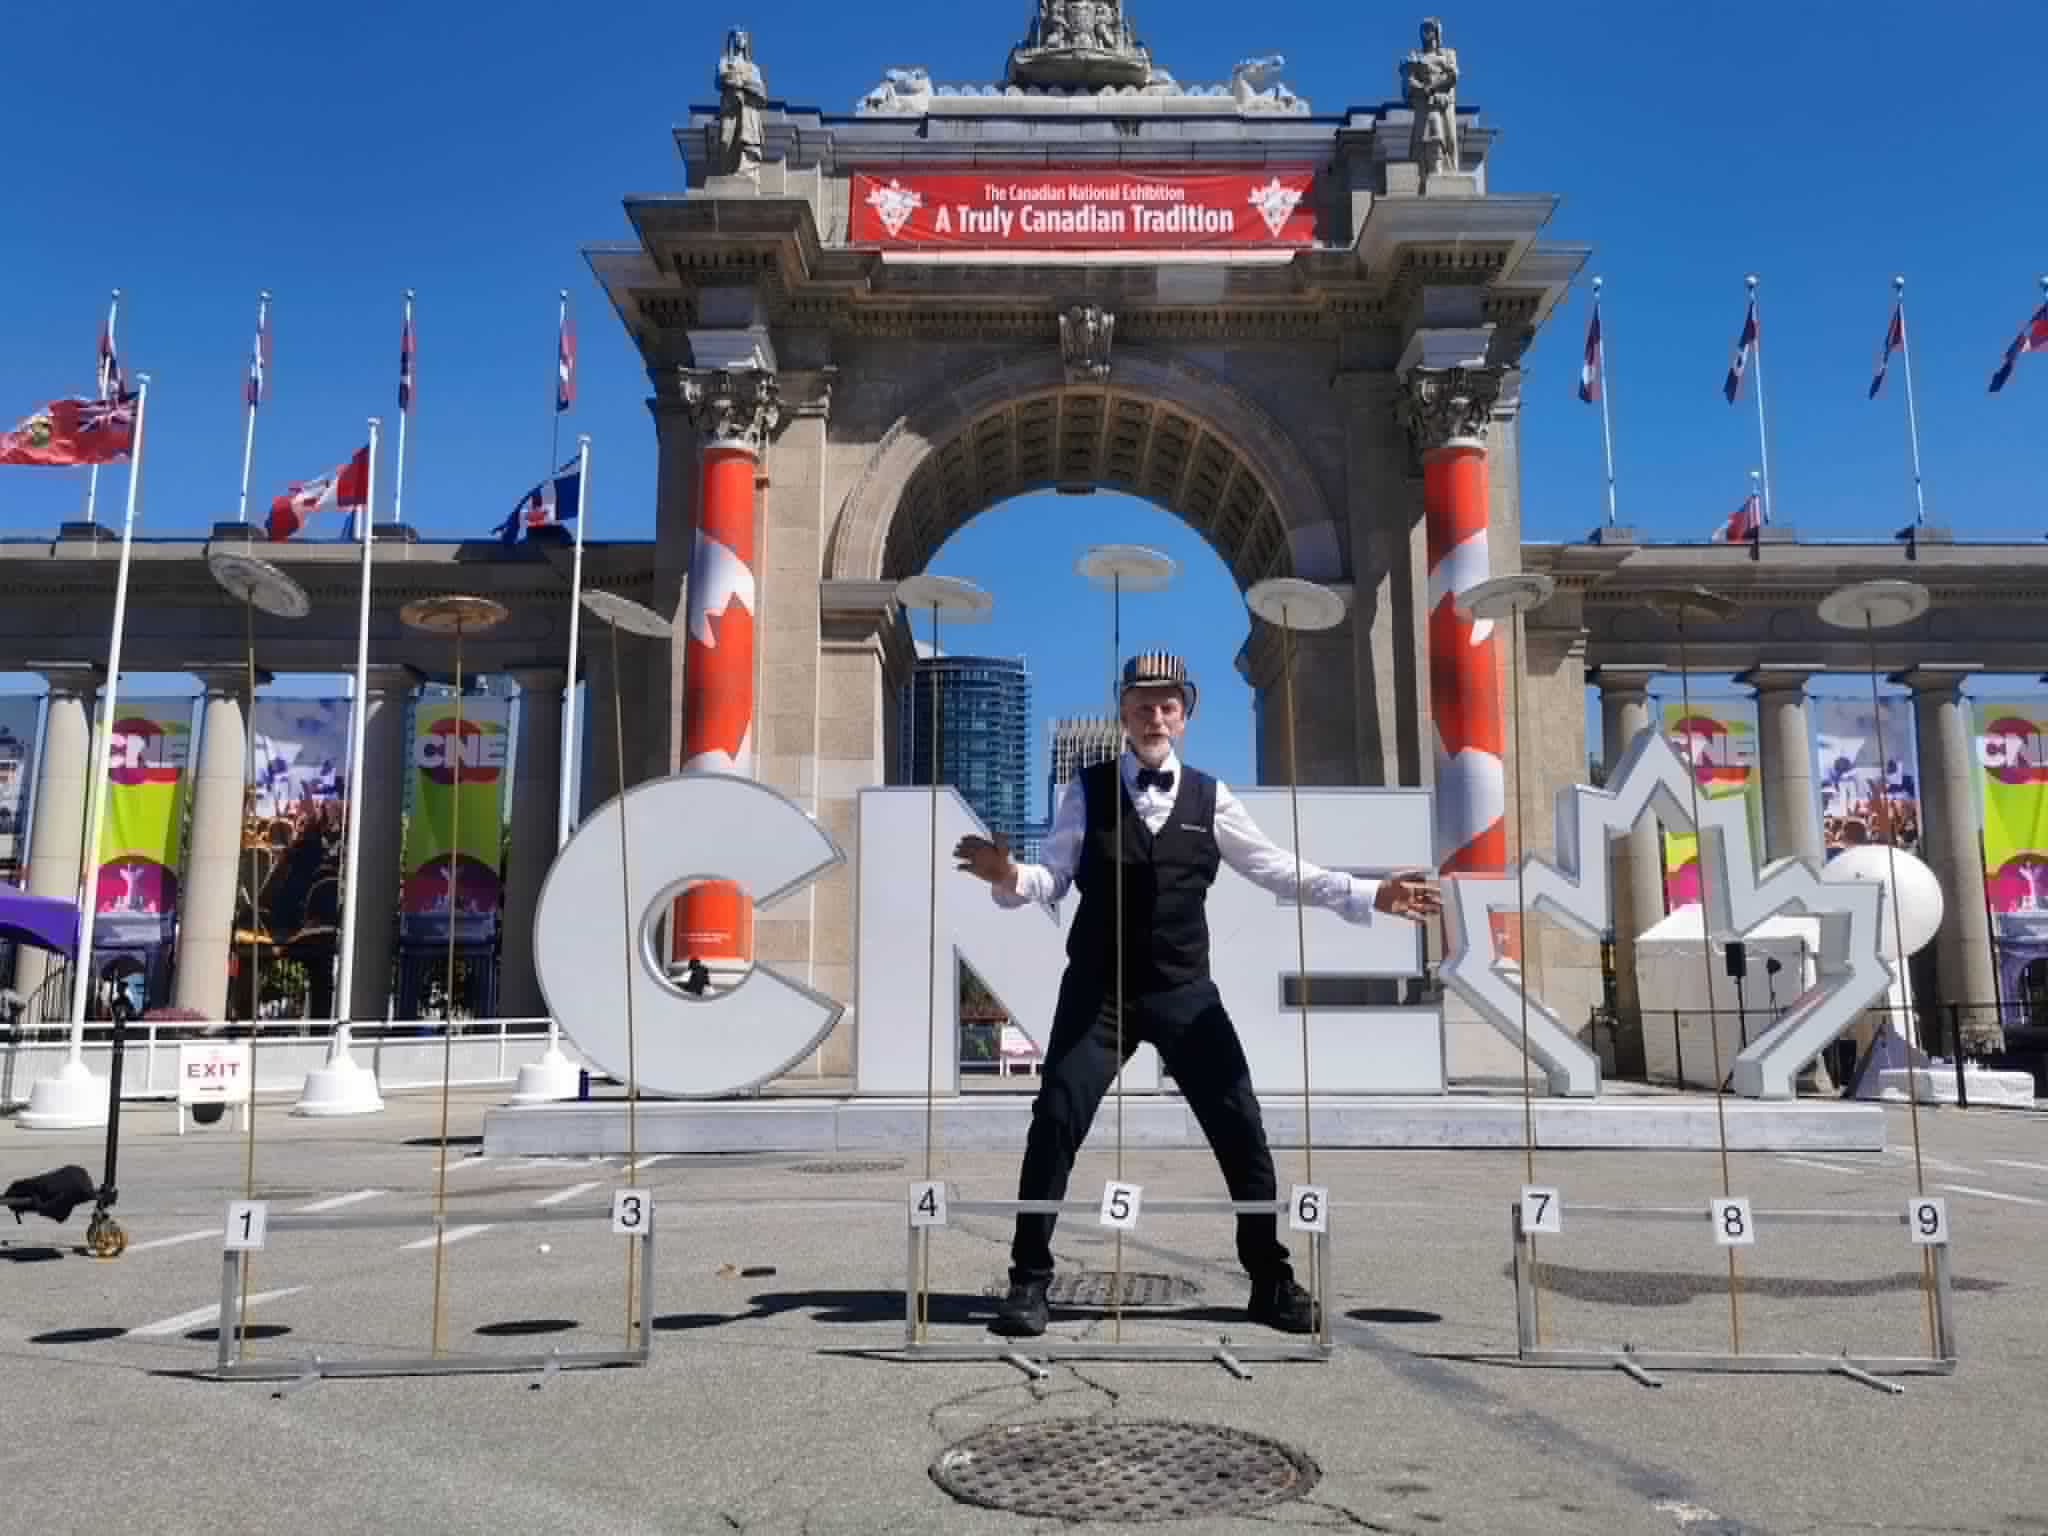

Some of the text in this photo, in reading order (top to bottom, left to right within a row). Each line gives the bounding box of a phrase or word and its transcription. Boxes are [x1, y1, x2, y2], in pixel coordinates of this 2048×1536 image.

[984, 183, 1186, 201] The Canadian National Exhibition
[935, 204, 952, 233] A
[957, 204, 1014, 238] Truly
[1020, 204, 1125, 233] Canadian
[1131, 204, 1234, 233] Tradition
[415, 735, 505, 768] CNE
[187, 1063, 241, 1079] EXIT
[621, 1196, 641, 1227] 3
[918, 1186, 939, 1217] 4
[1110, 1189, 1131, 1220] 5
[1298, 1191, 1319, 1223] 6
[1528, 1193, 1551, 1225] 7
[239, 1209, 252, 1241] 1
[1724, 1205, 1745, 1237] 8
[1918, 1204, 1938, 1236] 9
